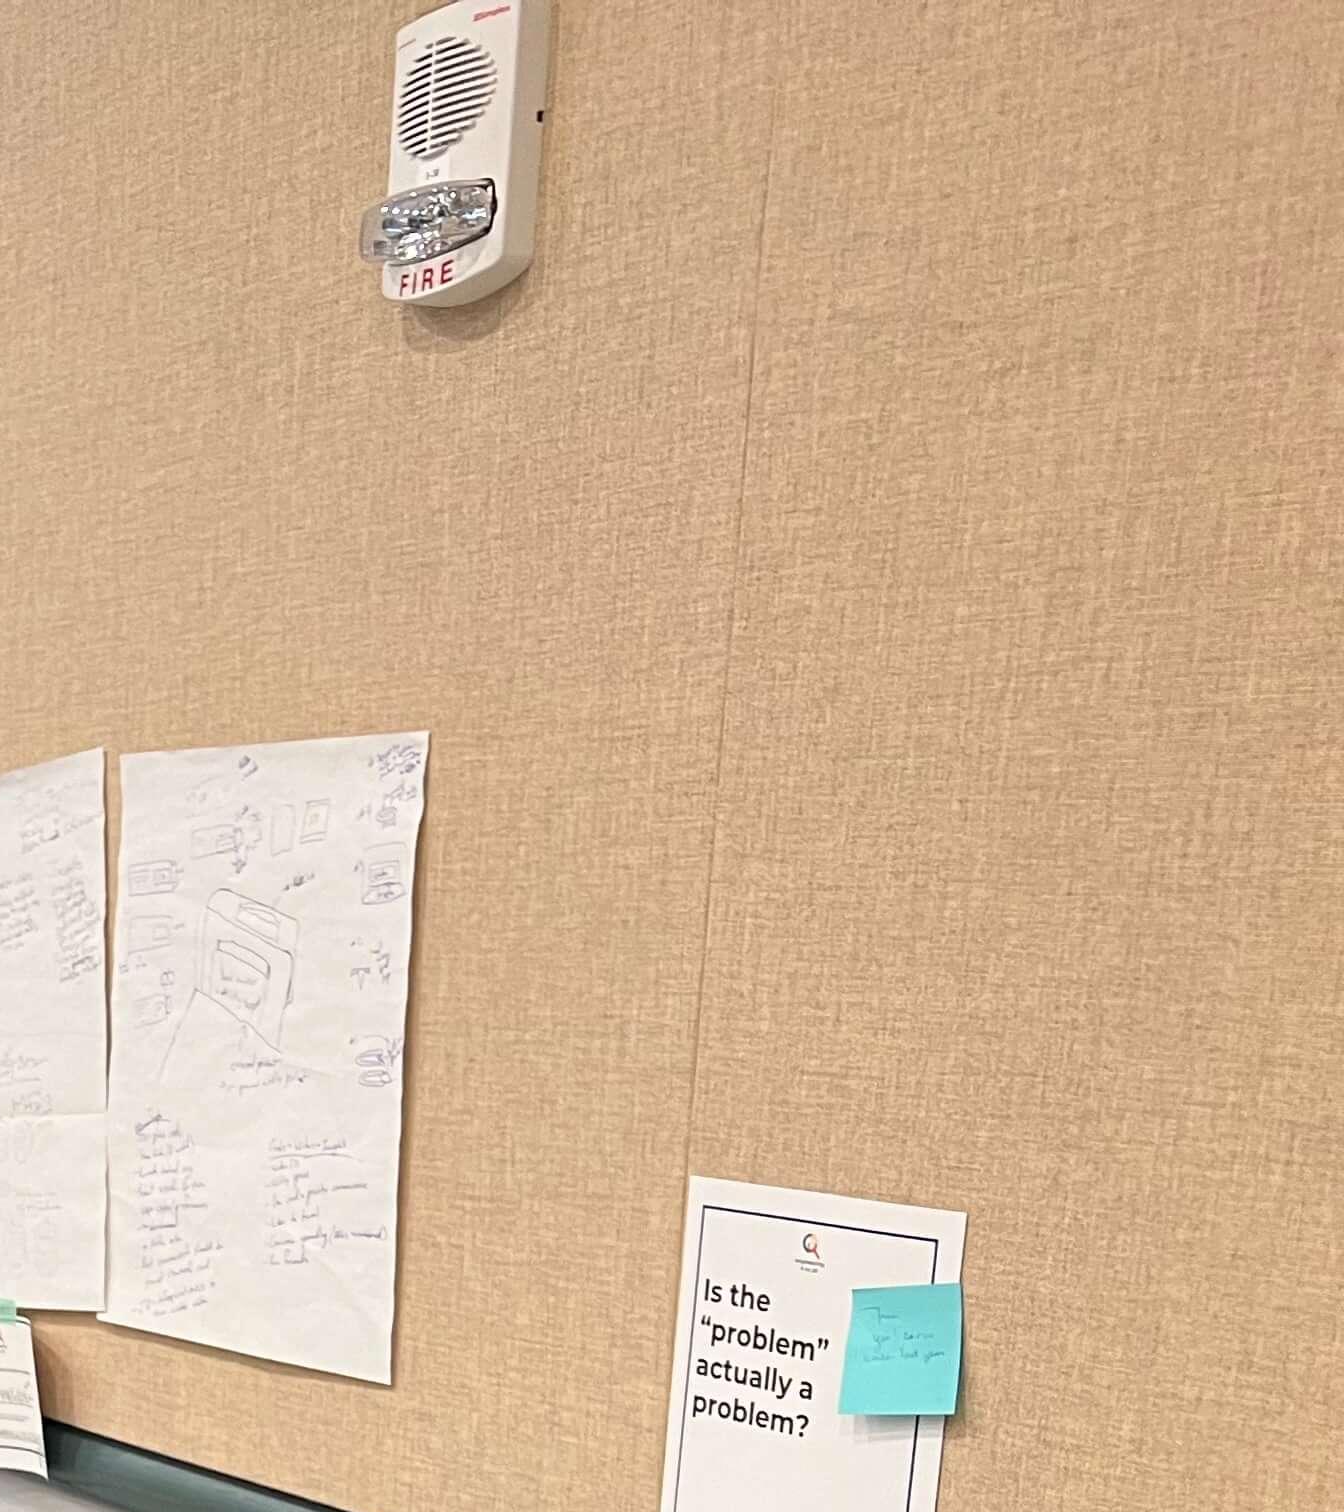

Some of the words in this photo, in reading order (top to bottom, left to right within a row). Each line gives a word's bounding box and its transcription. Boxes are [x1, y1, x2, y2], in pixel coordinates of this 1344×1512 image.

[400, 260, 454, 297] FIRE
[705, 1279, 722, 1303] Is
[731, 1282, 770, 1311] the
[701, 1316, 829, 1361] “problem”
[696, 1358, 792, 1399] actually
[799, 1379, 812, 1400] a
[692, 1393, 809, 1438] problem?
